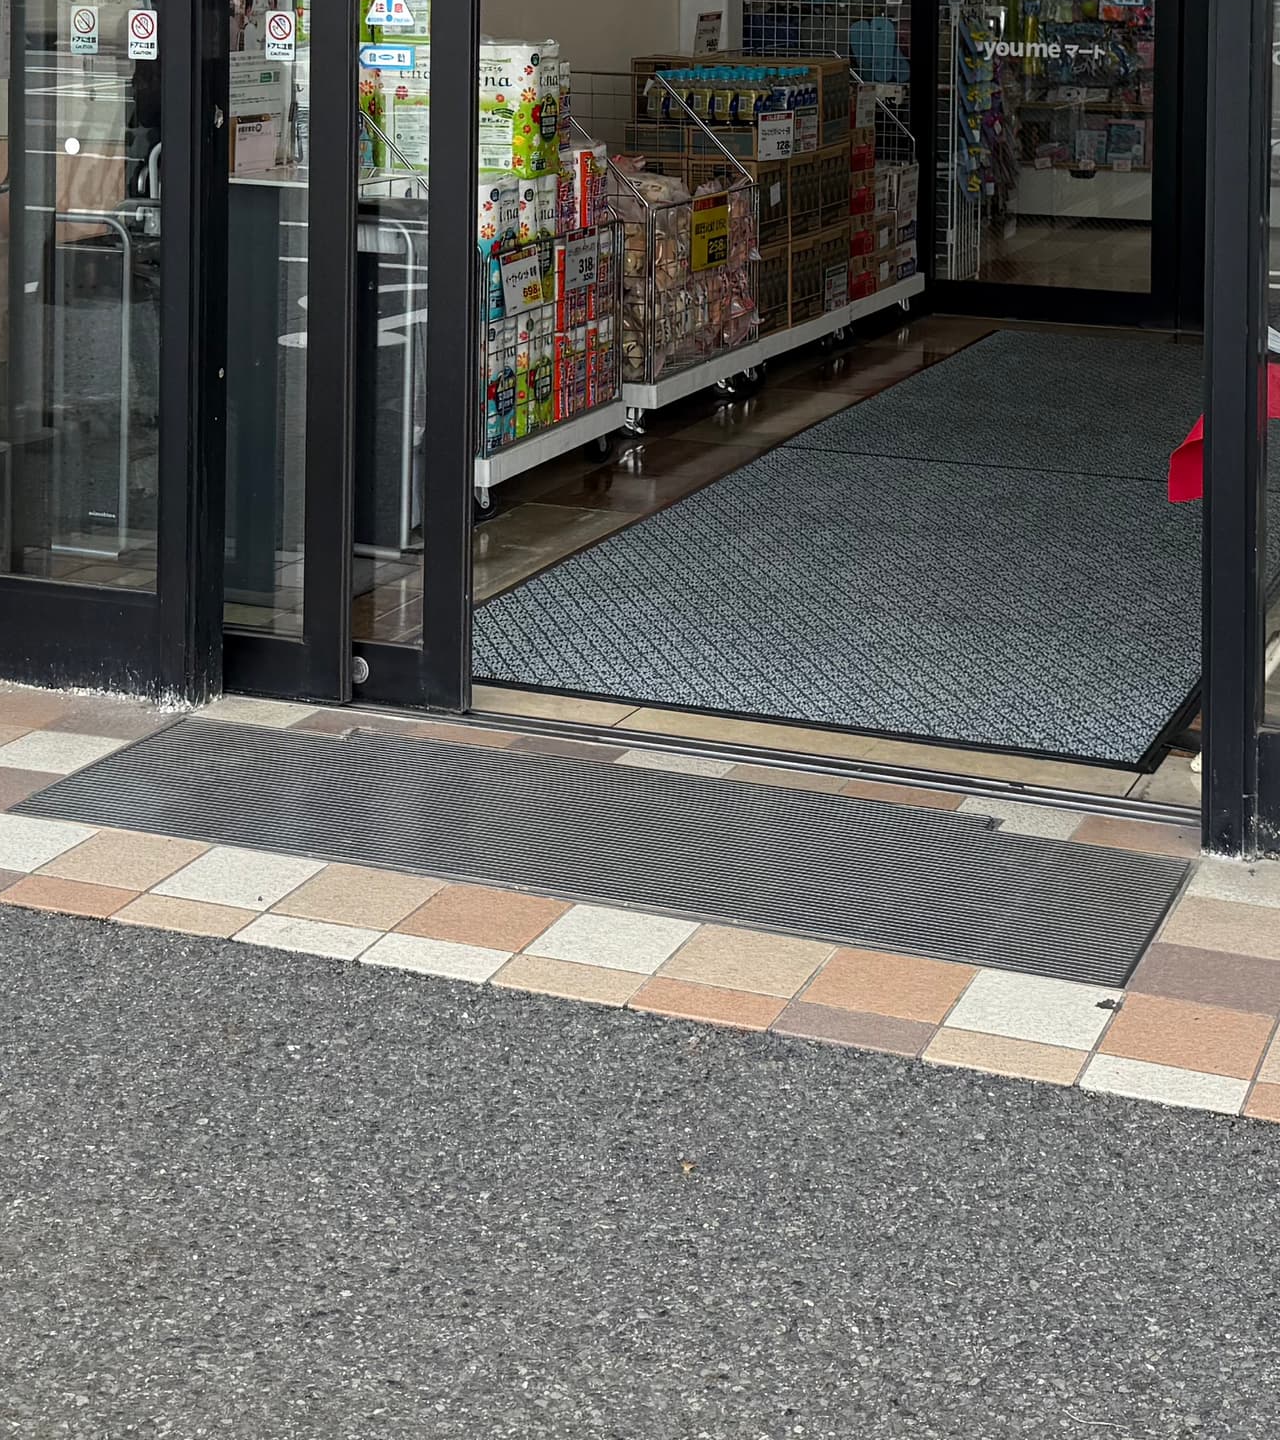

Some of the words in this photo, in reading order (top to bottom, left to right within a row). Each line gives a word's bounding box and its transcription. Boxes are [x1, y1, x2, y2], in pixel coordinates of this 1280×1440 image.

[984, 40, 1061, 60] youme
[1064, 44, 1106, 60] マート
